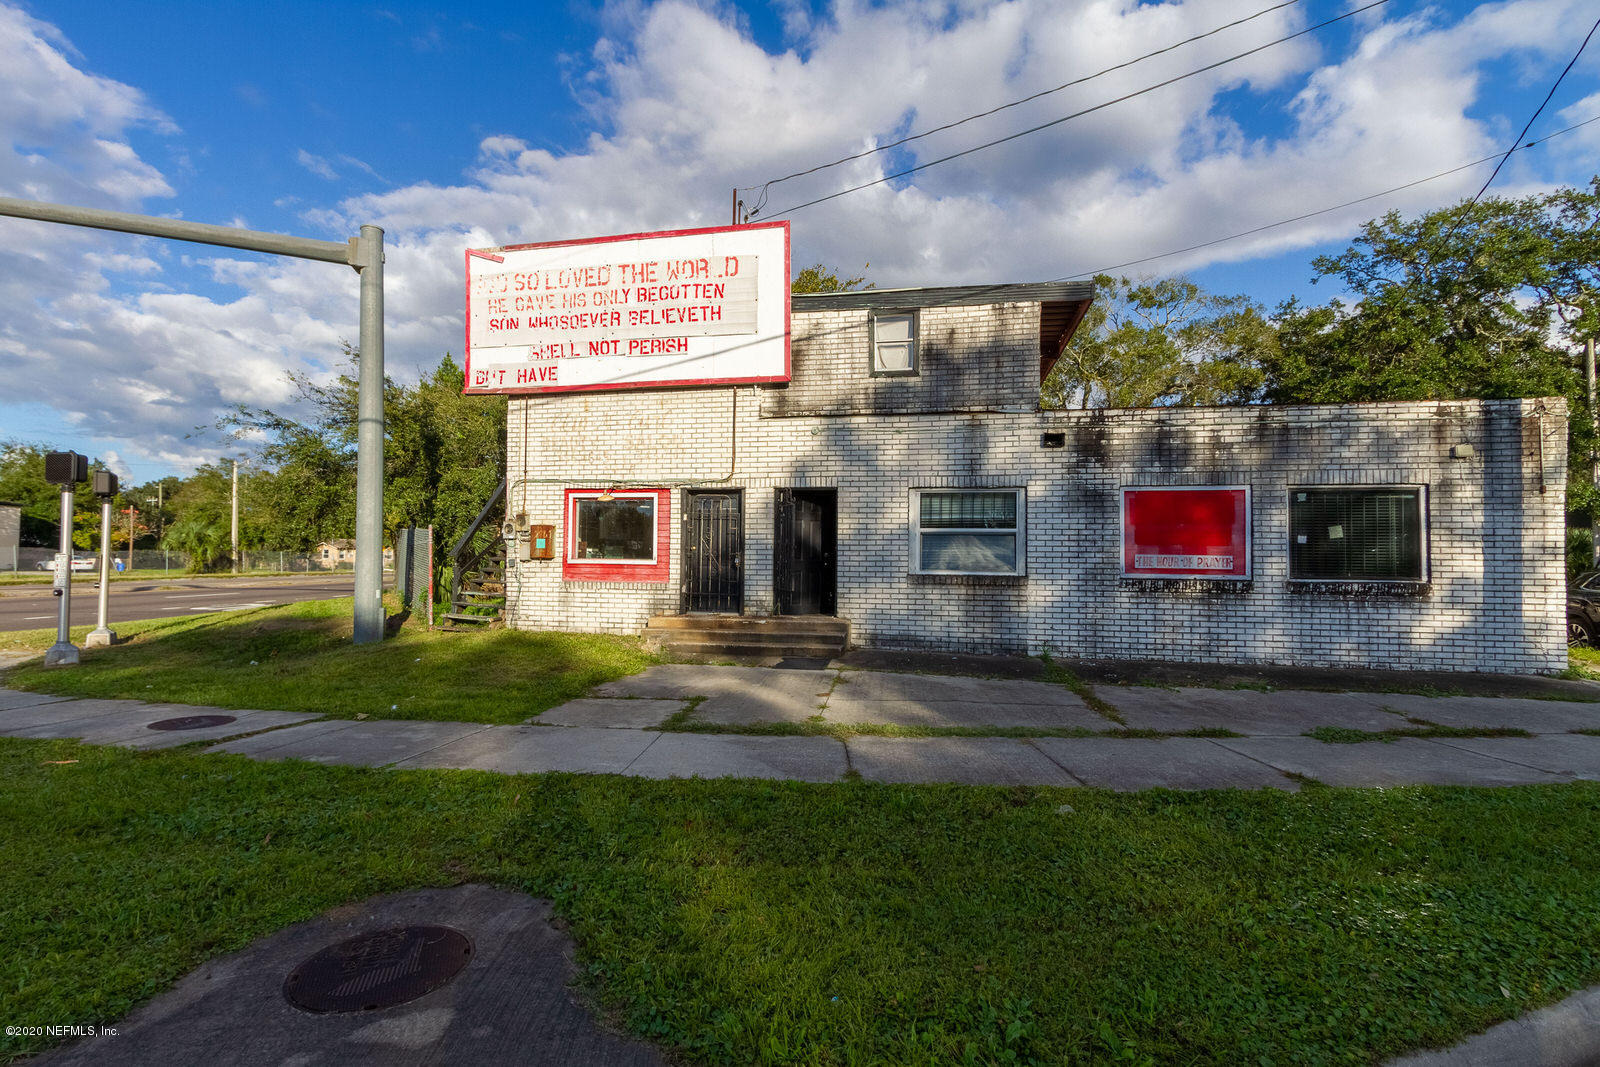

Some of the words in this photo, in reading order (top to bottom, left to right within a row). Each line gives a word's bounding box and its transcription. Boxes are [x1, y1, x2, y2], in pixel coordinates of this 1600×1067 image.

[514, 272, 539, 291] SO
[544, 266, 611, 290] LOVED
[617, 262, 658, 284] THE
[666, 256, 739, 281] WORD
[515, 293, 555, 312] GAVE
[562, 292, 587, 309] HIS
[593, 287, 631, 307] ONLY
[637, 283, 725, 303] BEGOTTEN
[489, 317, 520, 333] SON
[528, 310, 621, 330] WHOSOEVER
[628, 304, 722, 327] BELIEVETH
[588, 339, 621, 356] NOT
[629, 337, 688, 355] PERISH
[517, 366, 558, 384] HAVE
[1156, 556, 1180, 567] HOUR
[1197, 556, 1232, 568] PRAYER
